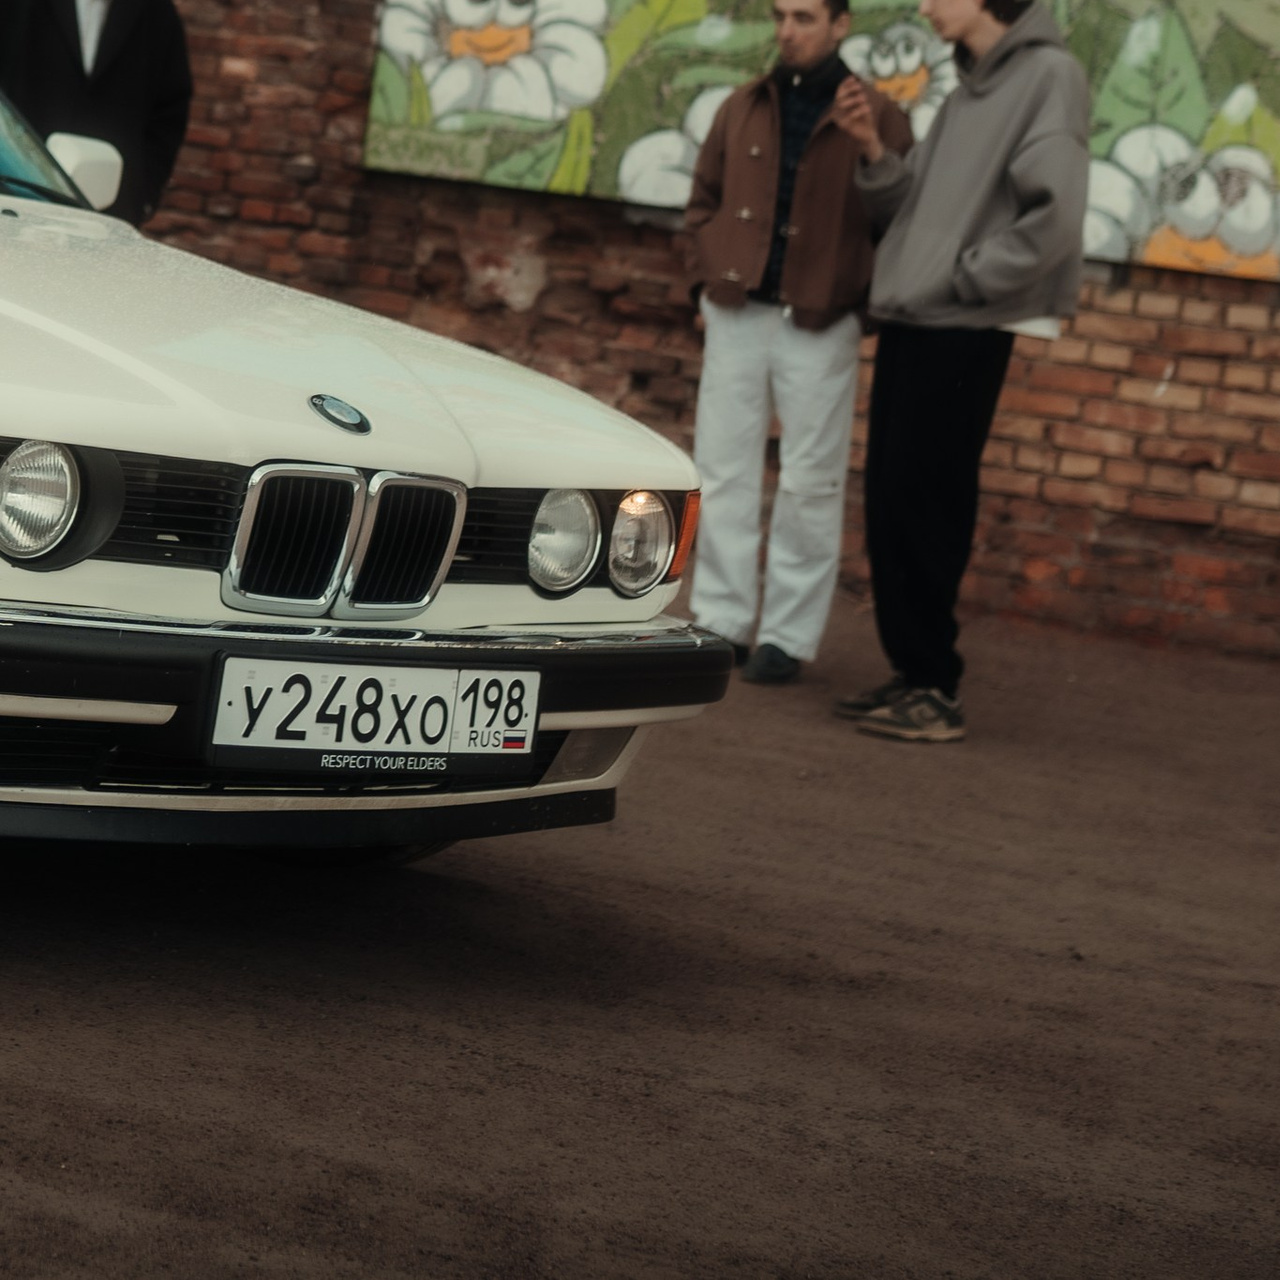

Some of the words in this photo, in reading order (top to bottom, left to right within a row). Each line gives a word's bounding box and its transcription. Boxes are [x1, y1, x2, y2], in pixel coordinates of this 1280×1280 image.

[460, 678, 525, 728] 198
[467, 730, 501, 748] RUS
[320, 754, 371, 769] RESPECT
[373, 756, 405, 770] YOUR
[407, 757, 447, 771] ELDERS
